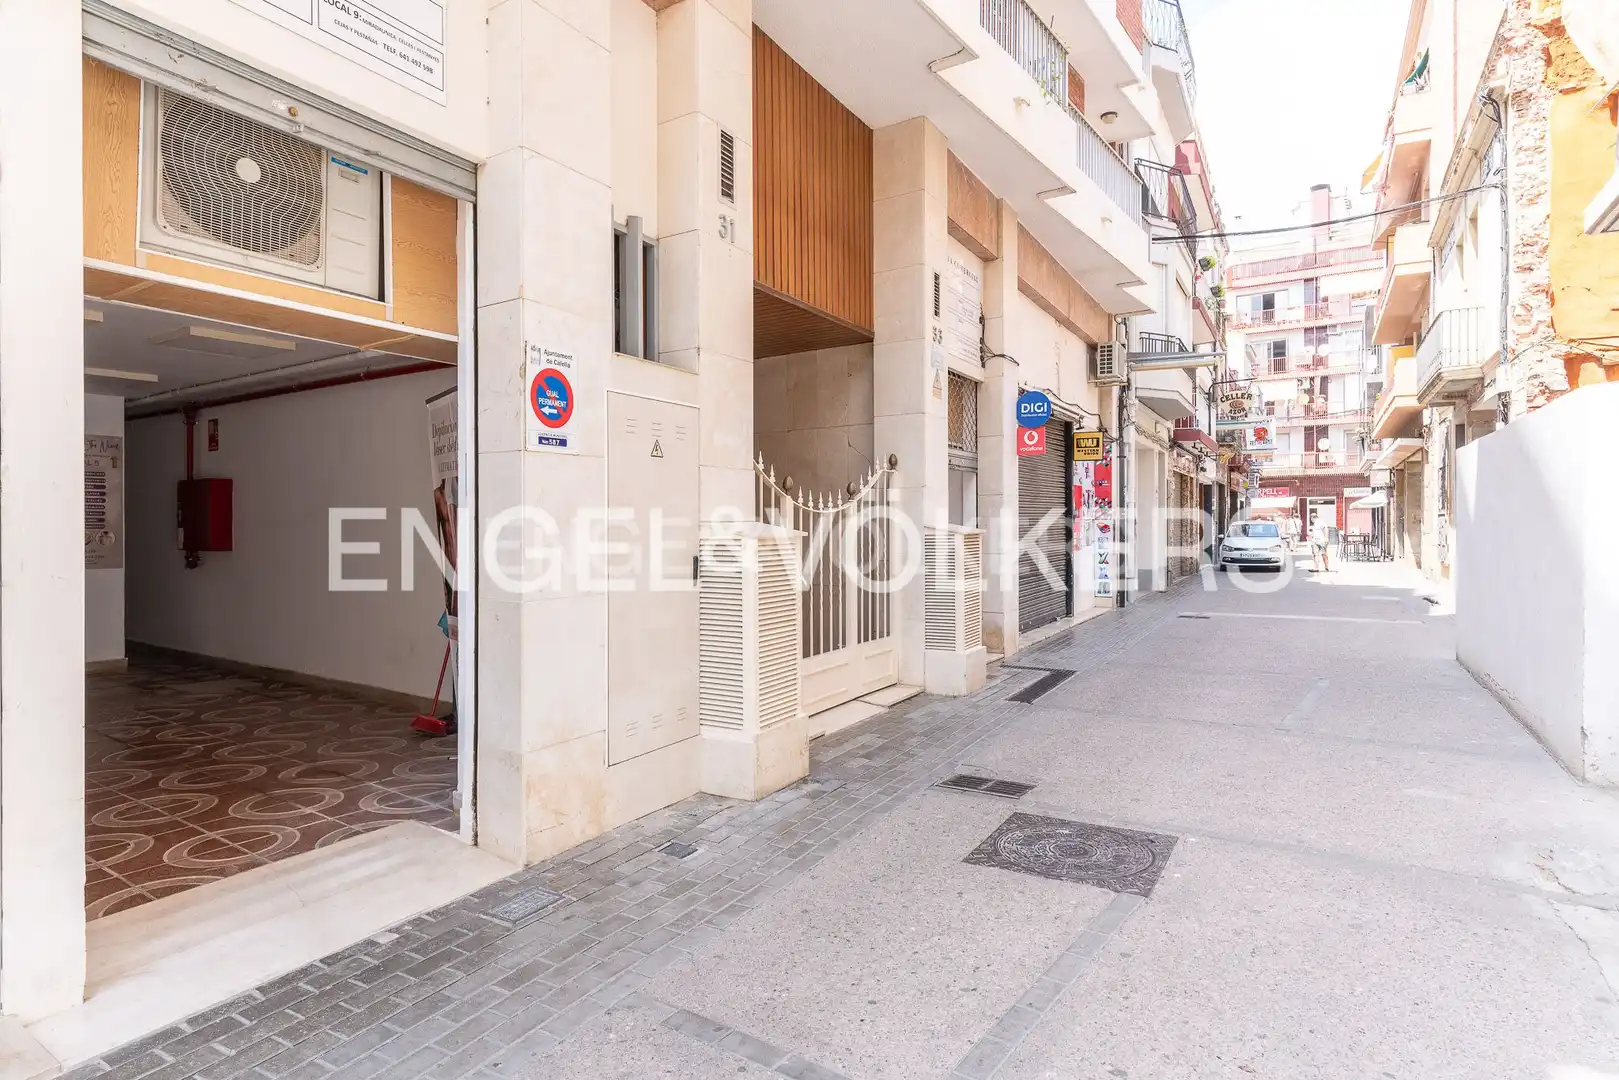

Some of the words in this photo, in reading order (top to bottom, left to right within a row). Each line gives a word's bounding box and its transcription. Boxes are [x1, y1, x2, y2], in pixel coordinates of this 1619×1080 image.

[333, 18, 350, 30] CEJAS
[398, 51, 410, 62] 641
[410, 58, 422, 68] 492
[422, 63, 434, 74] 598
[718, 214, 735, 243] 31
[543, 348, 573, 361] Ajuntament
[553, 358, 571, 369] Calella
[545, 389, 559, 399] GUAL
[1220, 392, 1253, 403] CELLER
[538, 397, 567, 408] PERMANENT
[1021, 402, 1047, 413] DIGI
[549, 438, 561, 446] 587
